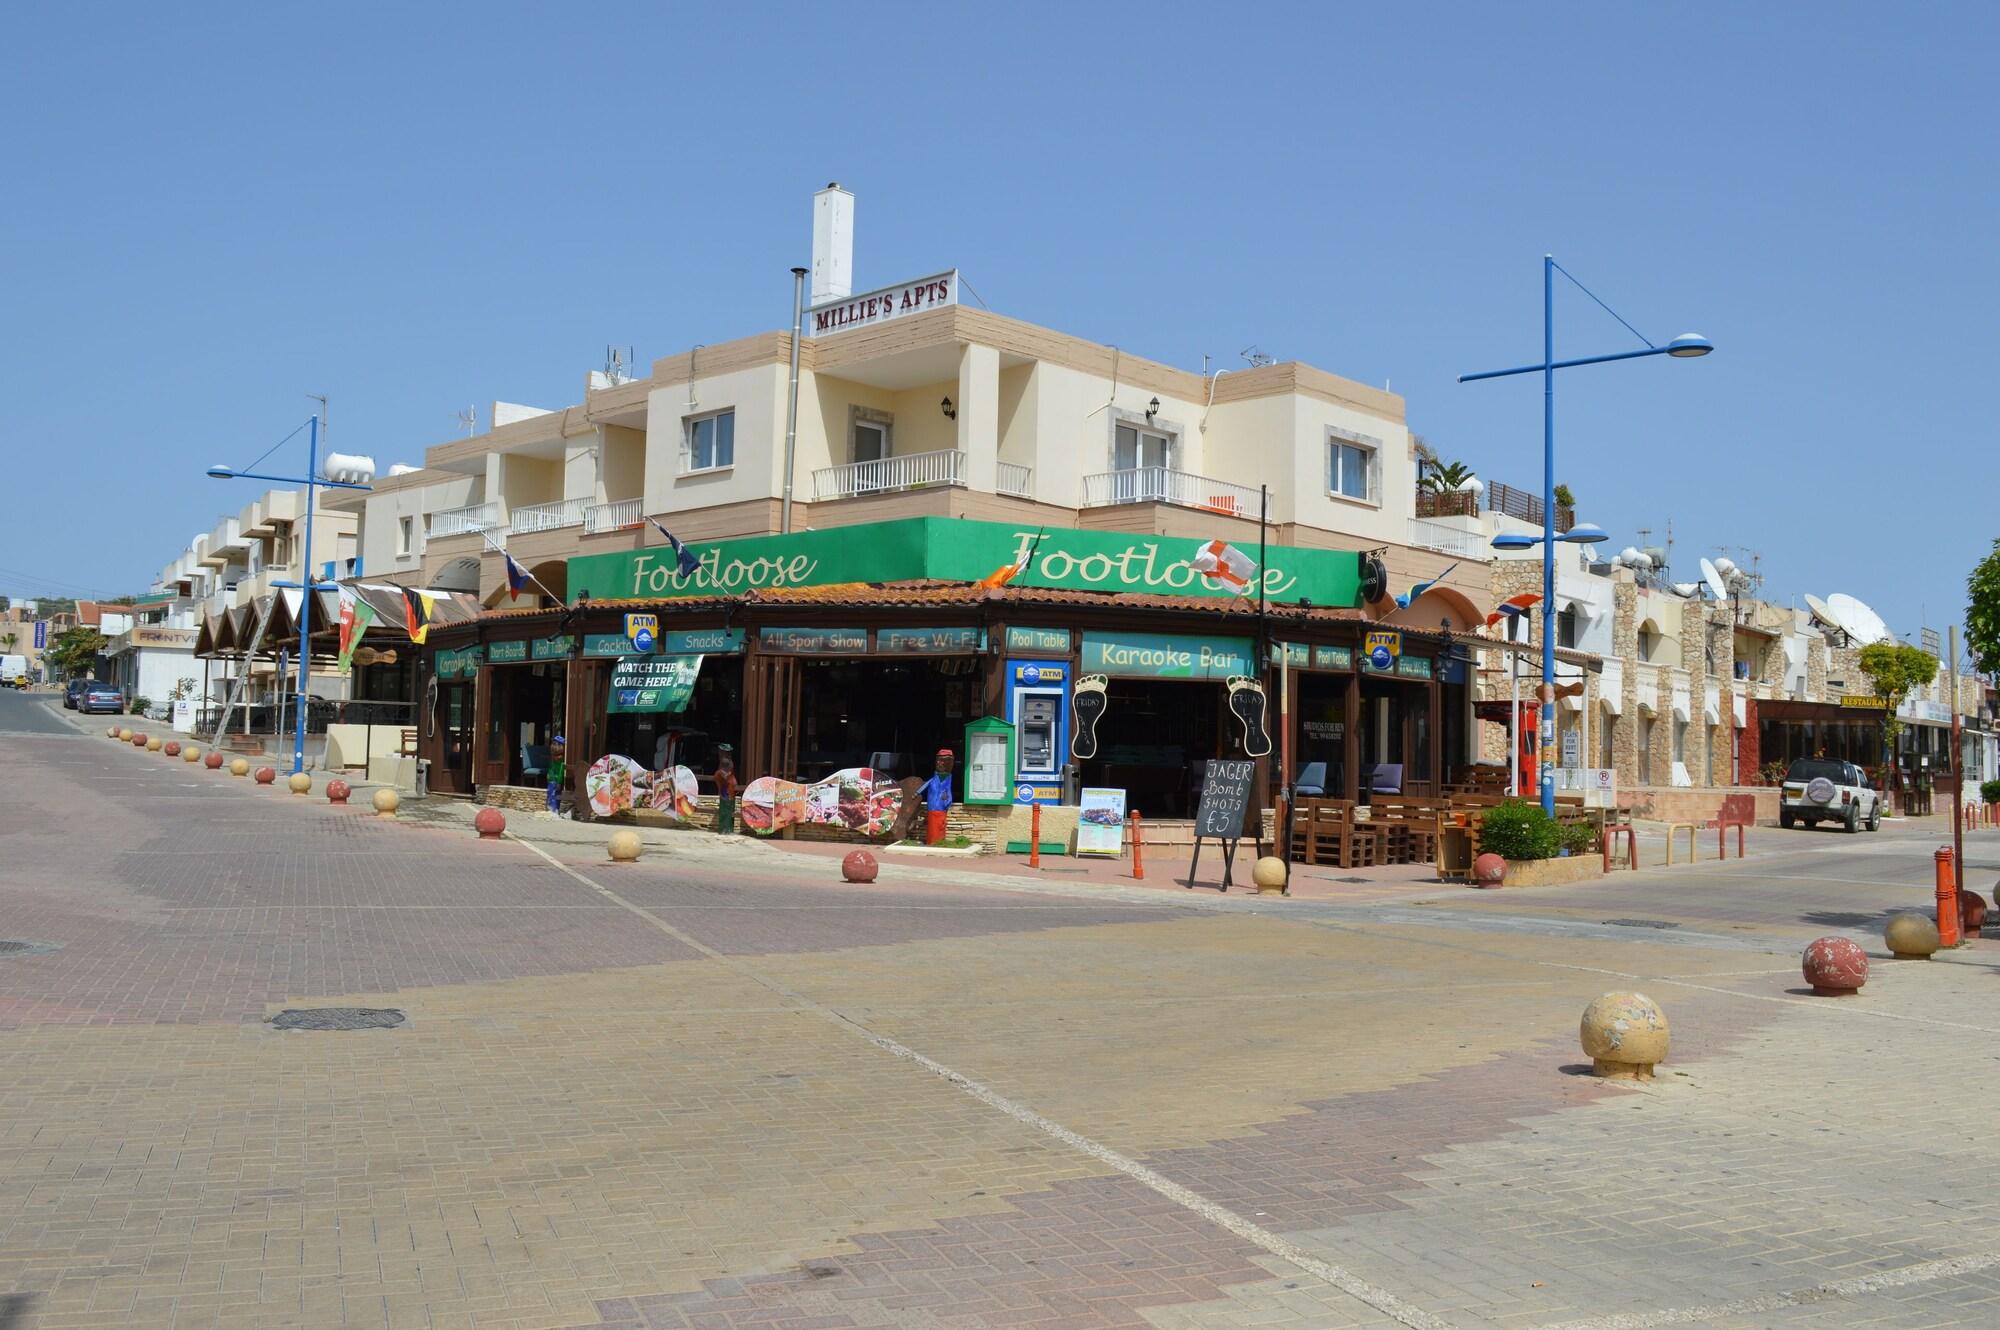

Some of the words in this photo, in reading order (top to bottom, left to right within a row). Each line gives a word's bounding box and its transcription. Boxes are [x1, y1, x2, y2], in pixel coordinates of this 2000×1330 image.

[816, 294, 893, 331] MILLIE'S
[900, 279, 948, 310] APTS
[1012, 531, 1297, 595] Footloe
[633, 548, 818, 595] Footloose
[632, 616, 656, 627] ATM
[598, 639, 632, 653] Cockta
[685, 632, 724, 649] Snacks
[767, 632, 783, 646] All
[787, 633, 824, 652] Sport
[829, 633, 864, 648] Show
[890, 633, 926, 648] Free
[931, 631, 977, 648] Wi-Fi
[1012, 631, 1033, 647] Pool
[1037, 632, 1066, 648] Table
[1369, 634, 1396, 645] ATM
[490, 645, 505, 658] Dart
[1101, 643, 1192, 667] Karaoke
[1199, 645, 1238, 668] Bar
[467, 656, 480, 671] Ba
[617, 662, 653, 673] WATCH
[655, 662, 677, 673] THE
[614, 676, 644, 687] GAME
[644, 676, 673, 687] HERE
[1076, 698, 1100, 708] FRIDAY
[1843, 695, 1894, 708] RESTAURAT
[1207, 762, 1251, 781] JAGER
[1203, 780, 1244, 796] Bomb
[1203, 797, 1242, 811] SHOTS
[1206, 810, 1231, 833] €3
